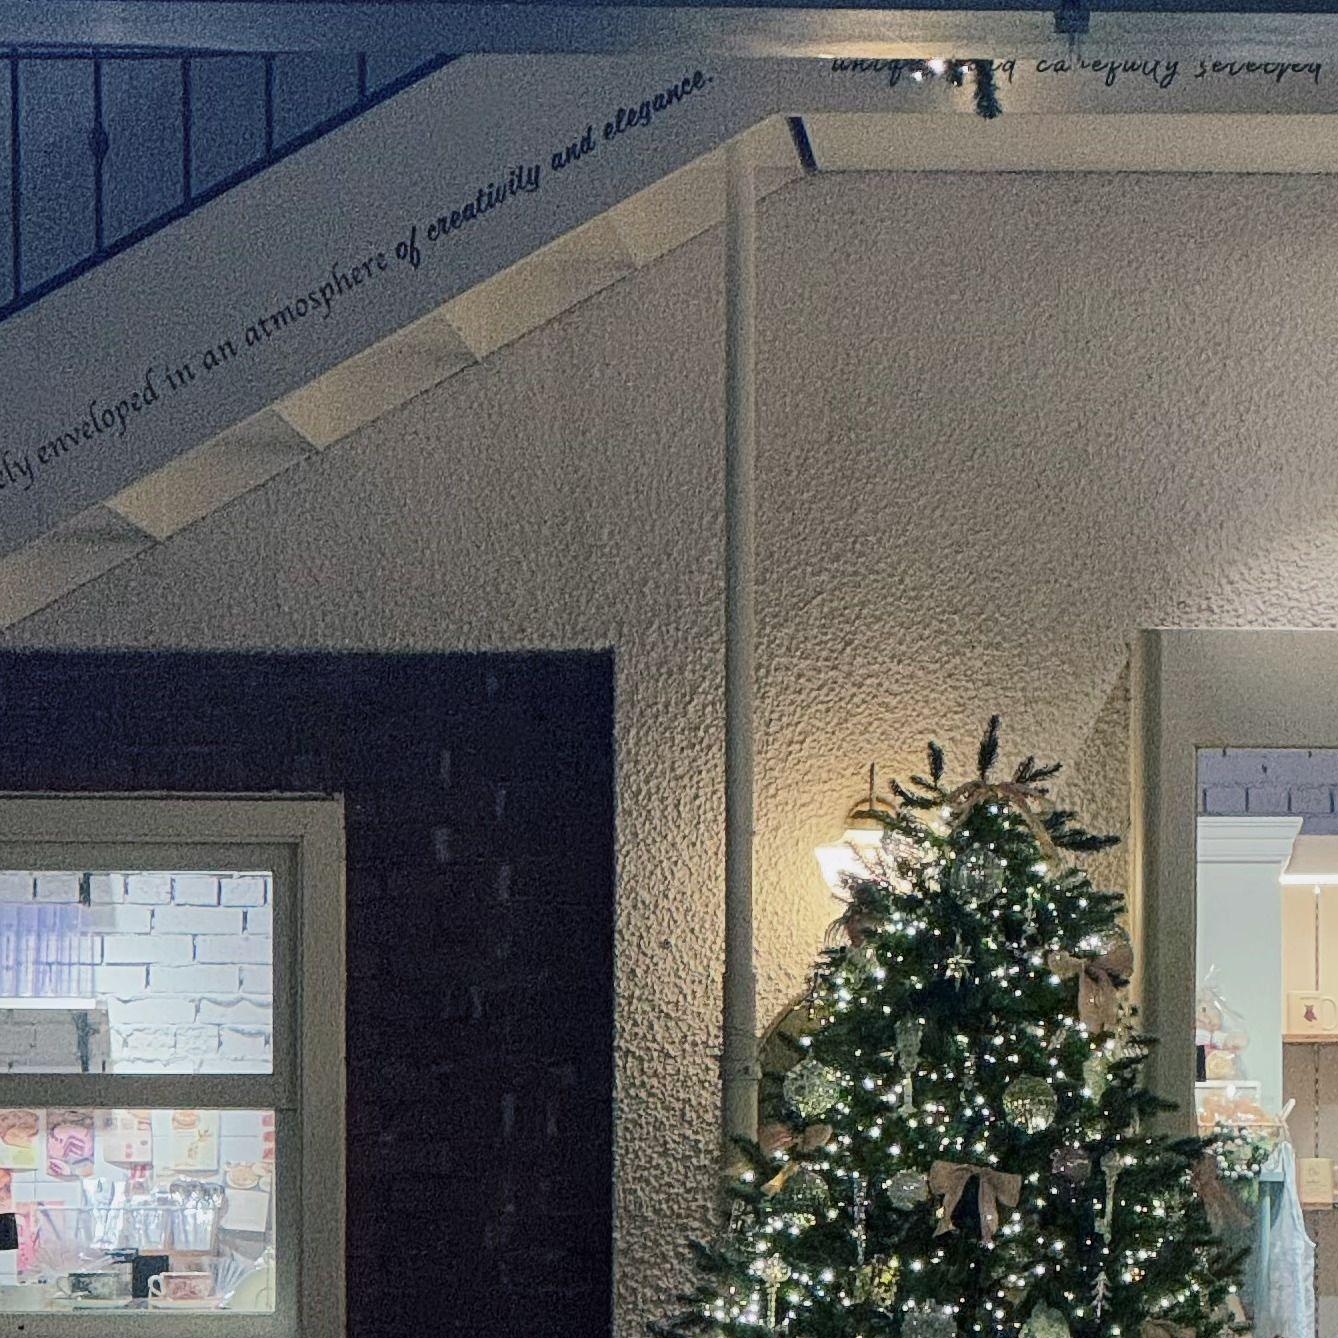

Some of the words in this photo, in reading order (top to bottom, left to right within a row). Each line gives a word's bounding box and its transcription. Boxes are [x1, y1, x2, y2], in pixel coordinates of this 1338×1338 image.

[37, 366, 160, 465] enveloped
[163, 361, 197, 392] in
[202, 338, 238, 372] an
[244, 252, 389, 347] atmosphere
[394, 225, 422, 271] of
[427, 164, 542, 243] creativity
[550, 125, 597, 172] and
[601, 69, 715, 141] elegance.
